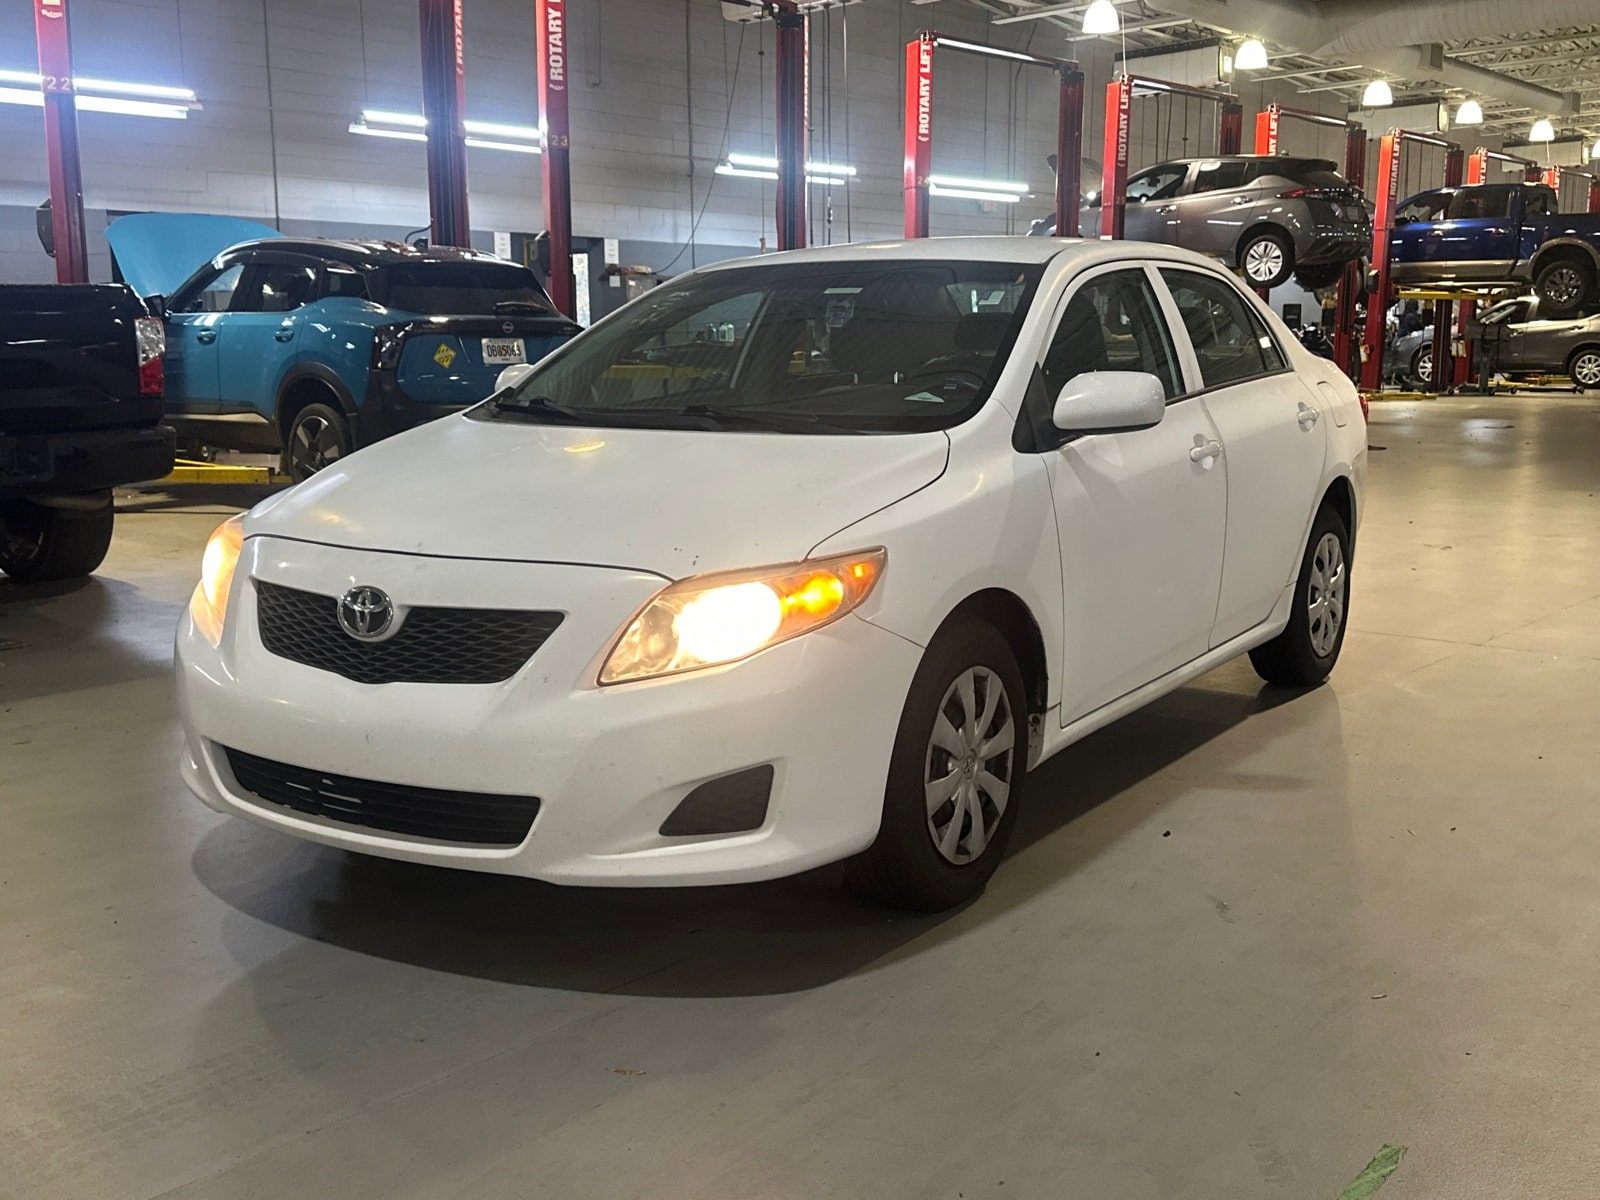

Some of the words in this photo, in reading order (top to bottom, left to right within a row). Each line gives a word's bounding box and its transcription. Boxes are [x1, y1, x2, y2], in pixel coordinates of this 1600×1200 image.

[548, 7, 563, 81] ROTARY
[920, 42, 931, 73] LIFT
[47, 76, 70, 91] 22
[1120, 83, 1129, 109] LIFT
[918, 75, 930, 134] ROTARY
[1118, 112, 1128, 160] ROTARY
[1269, 113, 1278, 135] LIFT
[552, 135, 567, 146] 23
[1393, 137, 1401, 157] LIFT
[1390, 160, 1399, 195] ROTARY
